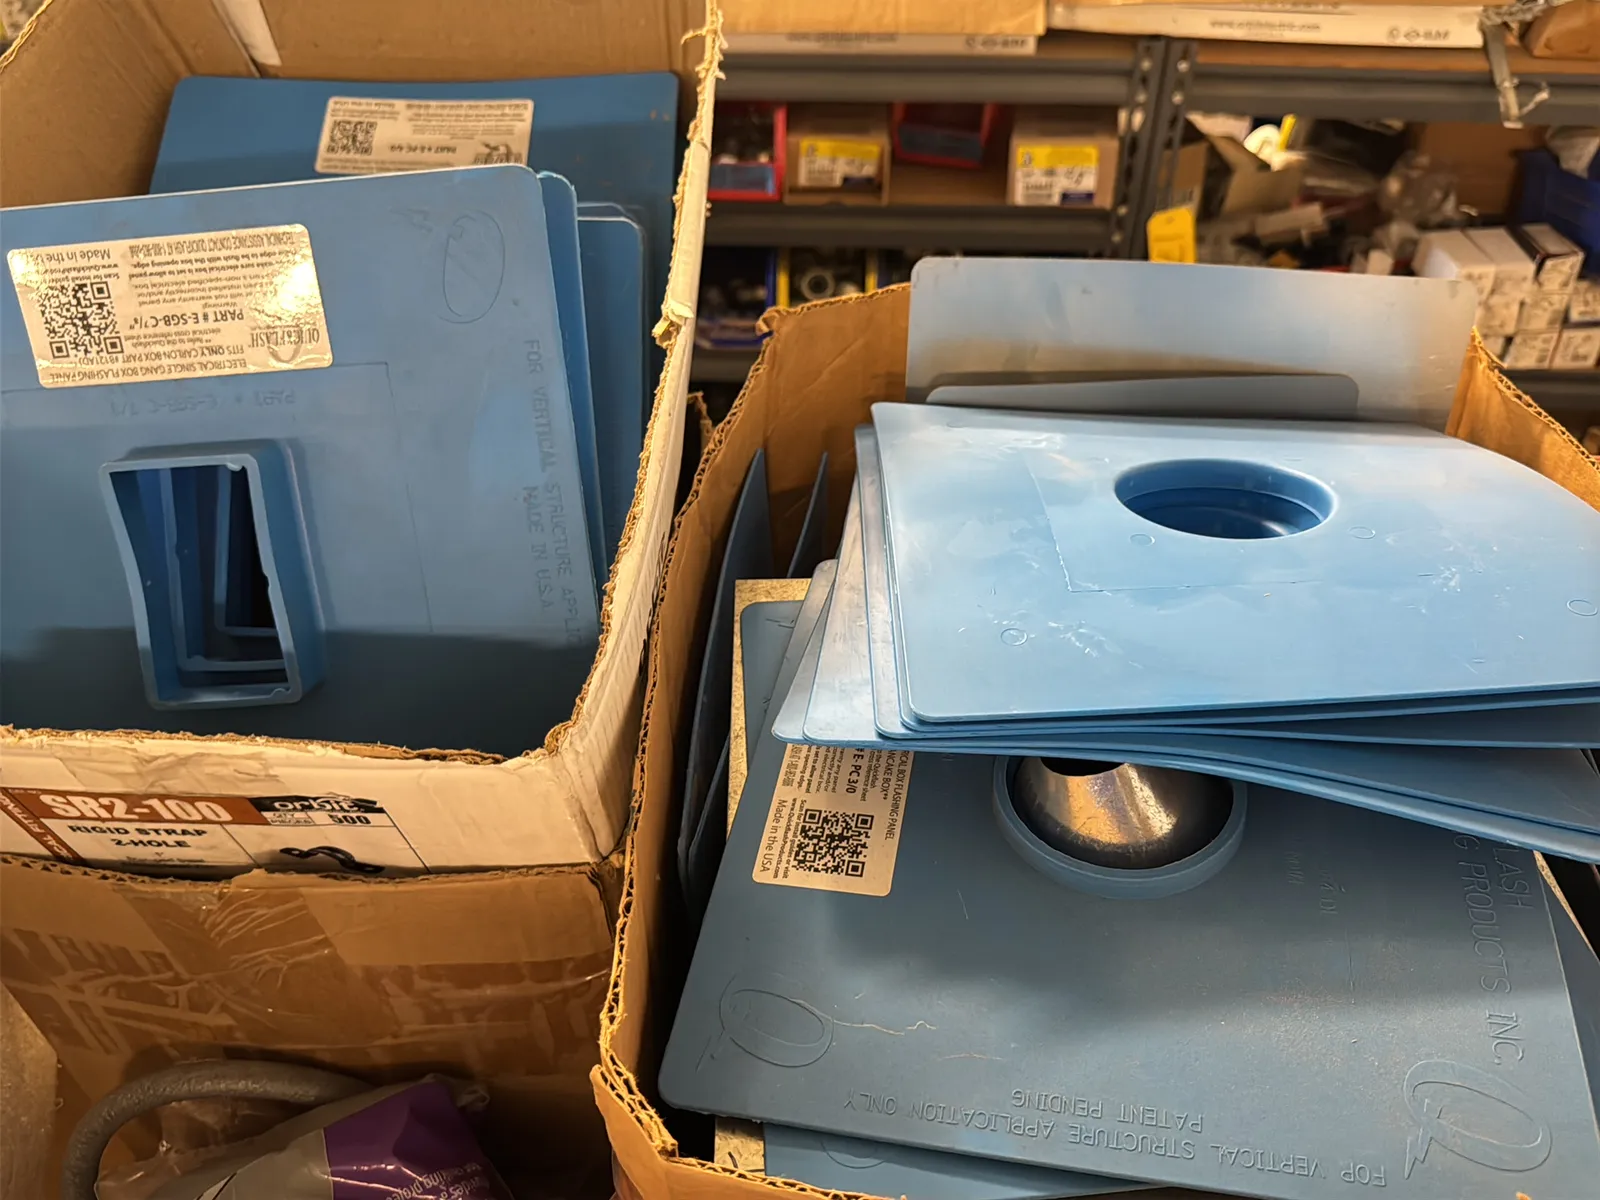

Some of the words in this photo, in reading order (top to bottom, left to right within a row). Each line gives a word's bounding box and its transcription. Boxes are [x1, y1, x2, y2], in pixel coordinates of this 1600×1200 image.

[44, 251, 65, 265] the
[65, 250, 78, 263] in
[78, 247, 112, 262] Made
[206, 255, 222, 263] with
[222, 254, 240, 262] flush
[258, 249, 277, 258] edge
[150, 258, 179, 267] opening
[180, 258, 193, 266] box
[193, 257, 206, 265] the
[147, 270, 167, 278] allow
[194, 266, 207, 274] box
[207, 264, 239, 273] electrical
[92, 273, 103, 281] for
[103, 272, 120, 280] Scan
[127, 270, 148, 280] panel
[185, 274, 241, 285] non-specified
[149, 280, 186, 288] electrical
[207, 283, 241, 292] installed
[135, 290, 164, 298] and/or
[163, 286, 206, 296] incorrectly
[137, 298, 161, 307] panel
[177, 293, 213, 302] warranty
[201, 311, 209, 323] #
[210, 308, 244, 322] PART
[123, 333, 142, 342] sheet
[142, 331, 173, 340] reference
[190, 327, 221, 336] electrical
[165, 338, 177, 346] the
[186, 336, 203, 344] Refer
[162, 348, 199, 359] CARLON
[198, 344, 225, 357] ONLY
[225, 344, 244, 354] FITS
[120, 352, 143, 363] PART
[143, 351, 162, 361] BOX
[139, 364, 165, 375] GANG
[165, 362, 197, 373] SINGLE
[196, 358, 247, 371] ELECTRICAL
[49, 371, 77, 382] PANEL
[76, 368, 120, 380] FLASHING
[119, 366, 139, 377] BOX
[524, 338, 544, 375] FOR
[545, 481, 572, 578] STRUCTURE
[531, 542, 548, 561] IN
[799, 753, 810, 774] opening
[874, 754, 882, 762] the
[808, 764, 817, 778] allow
[818, 753, 829, 779] electrical
[833, 763, 841, 774] any
[848, 764, 862, 776] PC
[823, 771, 832, 791] and/or
[862, 763, 873, 787] reference
[895, 768, 906, 782] BOX
[804, 778, 814, 793] panel
[830, 775, 839, 793] panel
[844, 777, 859, 794] 3/0
[859, 787, 868, 801] sheet
[888, 783, 903, 817] FLASHING
[39, 795, 233, 822] SR2-100
[772, 799, 788, 824] Made
[798, 799, 806, 812] Scan
[329, 814, 372, 826] 500
[795, 812, 803, 821] for
[67, 825, 130, 836] RIGID
[134, 826, 208, 838] STRAP
[769, 825, 781, 834] in
[883, 817, 897, 841] PANEL
[110, 838, 192, 849] 2-HOLE
[764, 835, 778, 851] the
[772, 797, 798, 879] www.QuickflashProducts.com
[785, 838, 797, 857] guides
[759, 853, 774, 872] USA
[781, 866, 790, 879] visit
[1458, 861, 1512, 994] PRODUCTS
[1484, 1008, 1526, 1067] INC.
[843, 1089, 897, 1117] ONLY
[1011, 1087, 1103, 1120] PENDING
[908, 1102, 1056, 1139] APPLICATION
[1116, 1104, 1204, 1134] PATENT
[1068, 1122, 1196, 1161] STRUCTURE
[1210, 1142, 1327, 1179] VERTICAL
